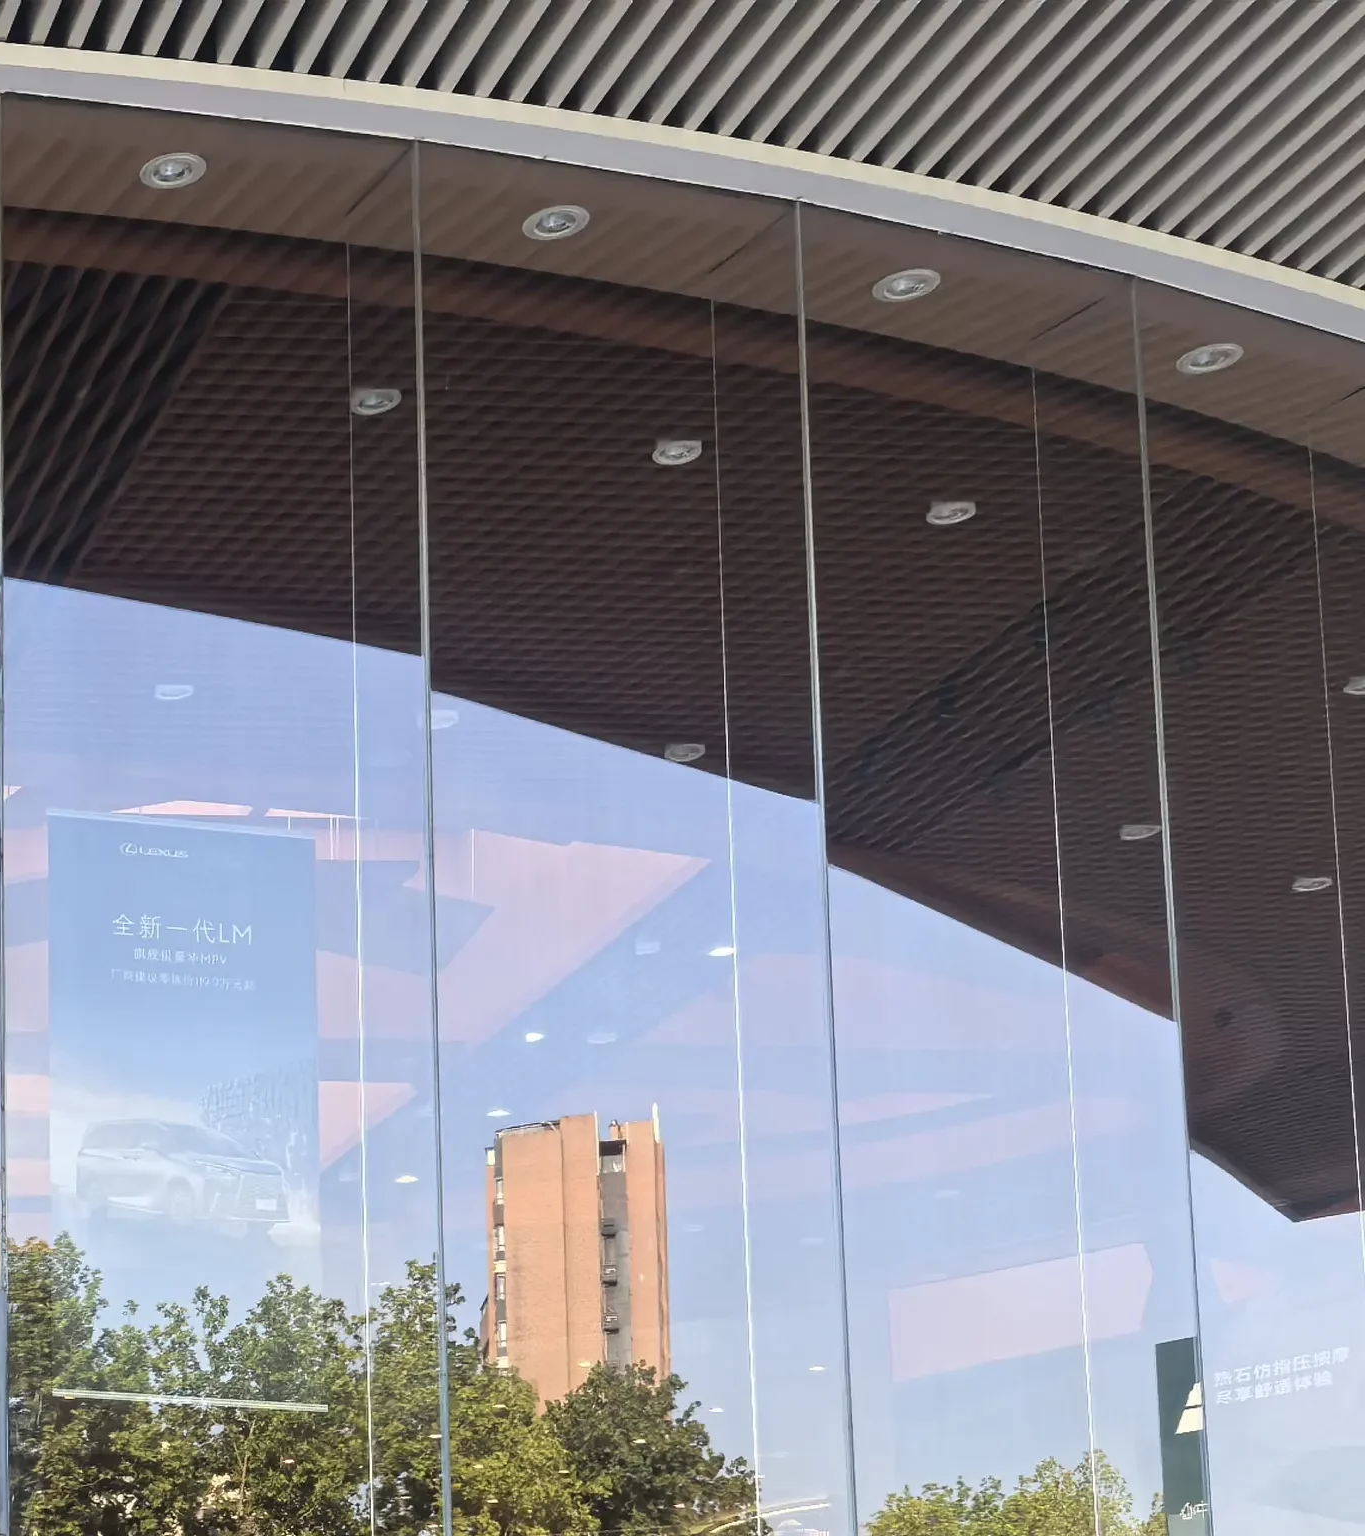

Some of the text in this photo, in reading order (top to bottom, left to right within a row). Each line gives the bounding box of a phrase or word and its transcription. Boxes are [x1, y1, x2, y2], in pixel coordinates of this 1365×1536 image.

[138, 846, 189, 858] LEXUS
[112, 913, 253, 946] 全新一代LM
